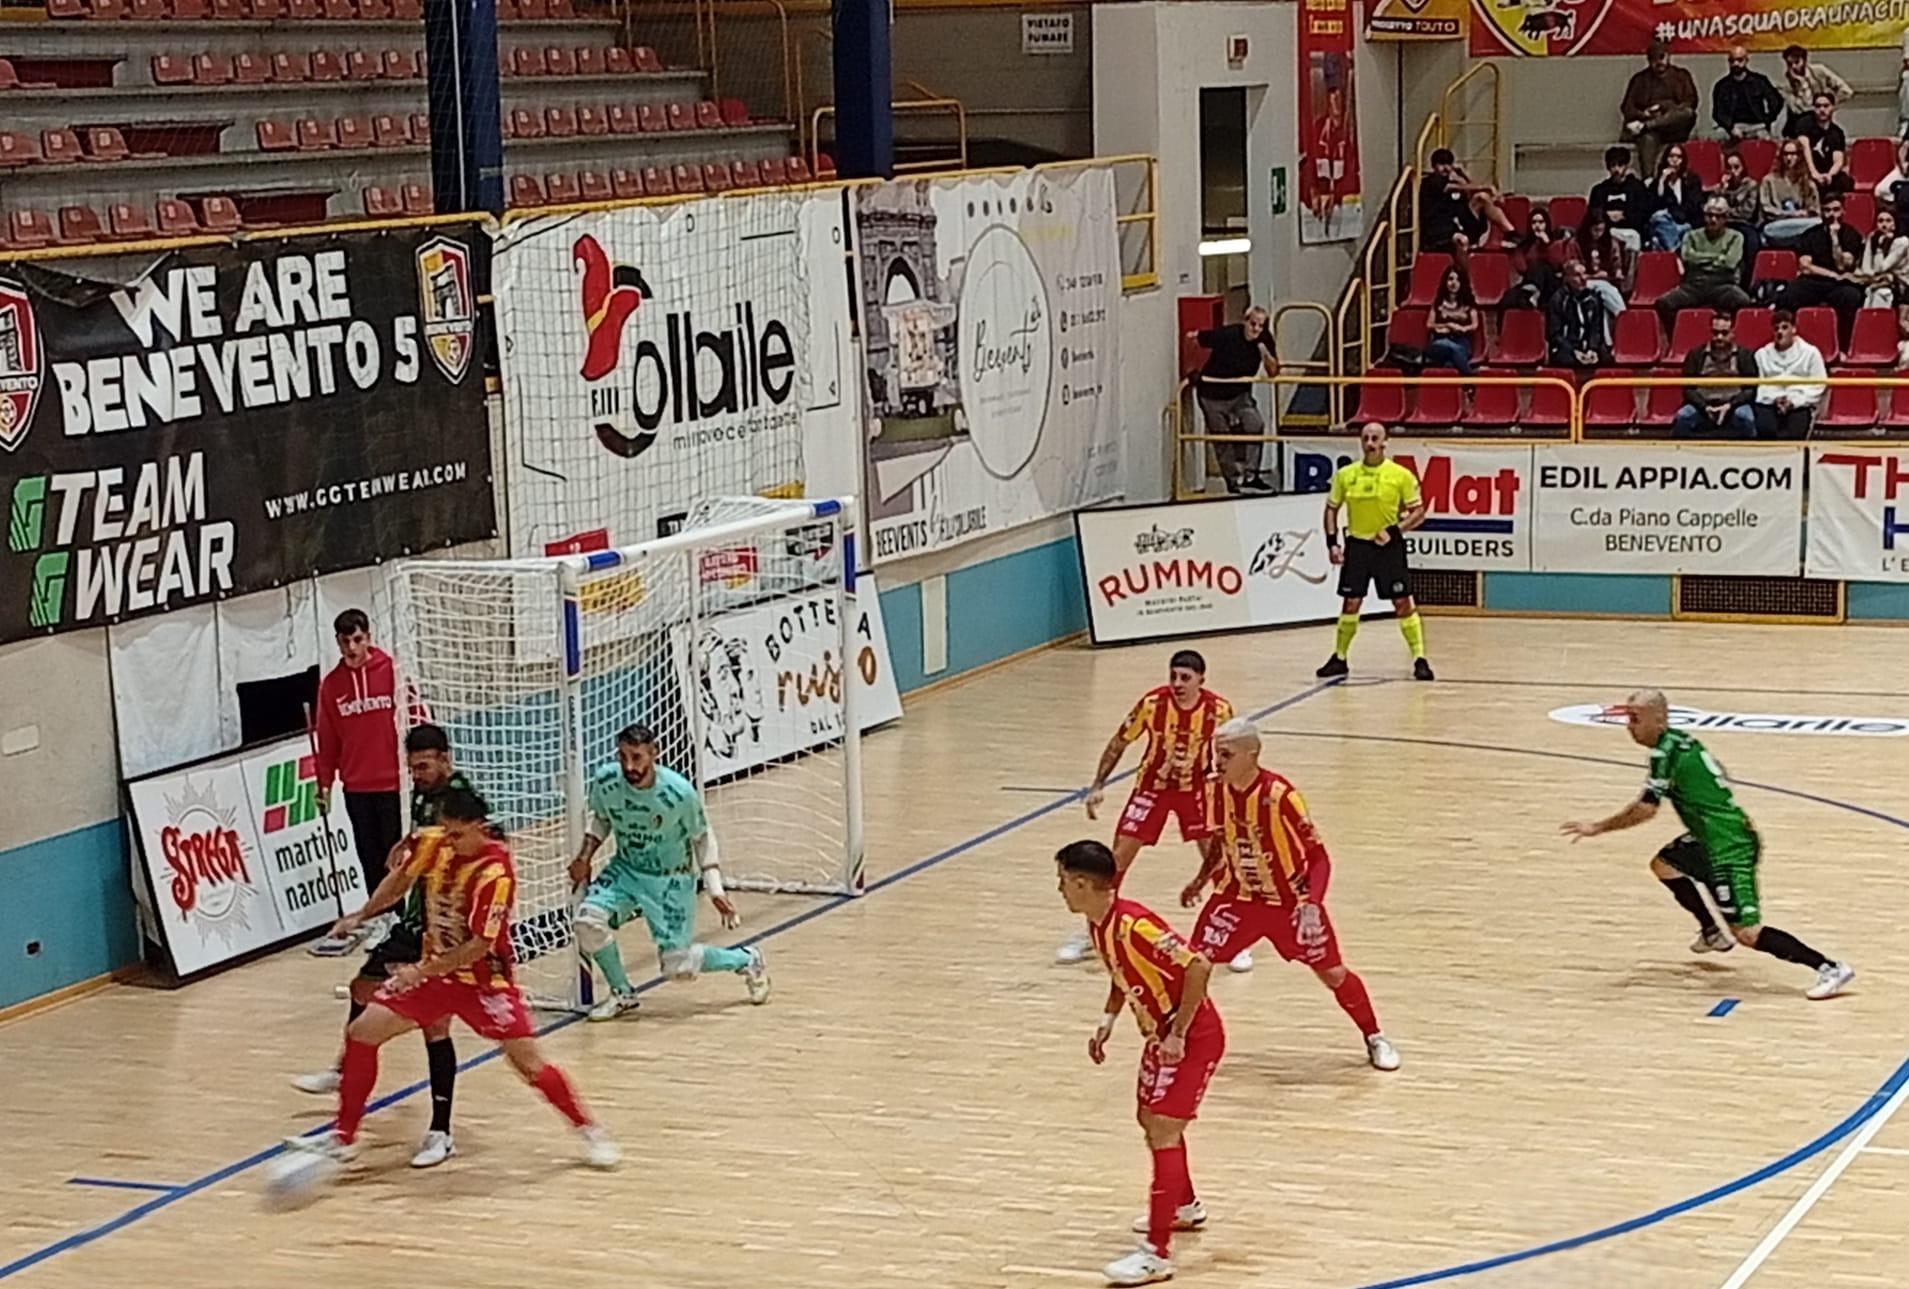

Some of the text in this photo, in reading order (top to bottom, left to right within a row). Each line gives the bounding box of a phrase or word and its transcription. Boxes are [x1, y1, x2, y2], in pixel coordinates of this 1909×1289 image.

[111, 250, 351, 348] WE ARE
[53, 316, 420, 436] BENEVENTO 5
[50, 452, 206, 546] TEAM
[1540, 466, 1793, 490] EDIL APPIA.COM
[1570, 507, 1759, 530] C.da Piano Cappelle
[1404, 539, 1515, 557] BUILDERS
[1605, 535, 1722, 553] BENEVENTO
[75, 521, 236, 621] WEAR
[1098, 559, 1243, 608] RUMMO
[765, 598, 872, 662] BOTTEA
[159, 824, 252, 922] STREGA
[274, 826, 350, 873] martino
[285, 866, 361, 912] nardone
